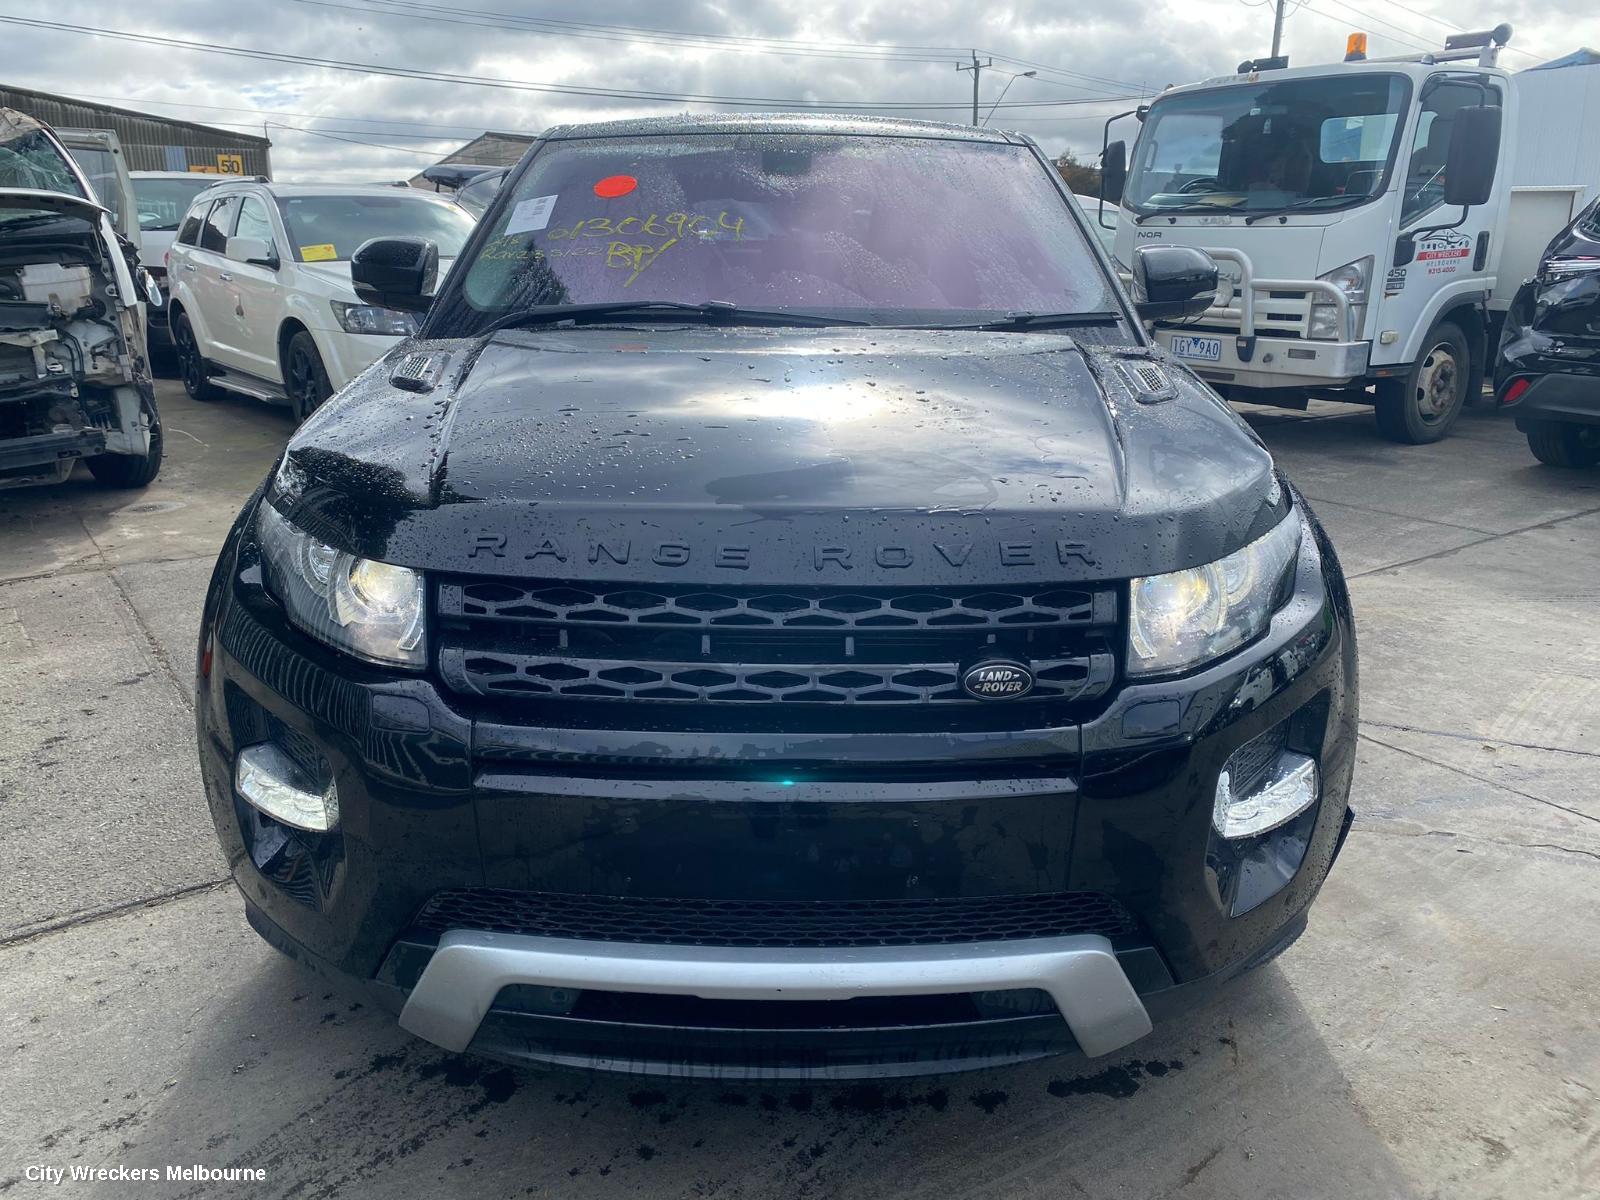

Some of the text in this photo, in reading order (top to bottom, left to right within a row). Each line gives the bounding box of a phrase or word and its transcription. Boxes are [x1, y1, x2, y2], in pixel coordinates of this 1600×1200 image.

[221, 159, 240, 173] 50
[1387, 268, 1407, 278] 450
[467, 531, 1098, 572] RANGE ROVER
